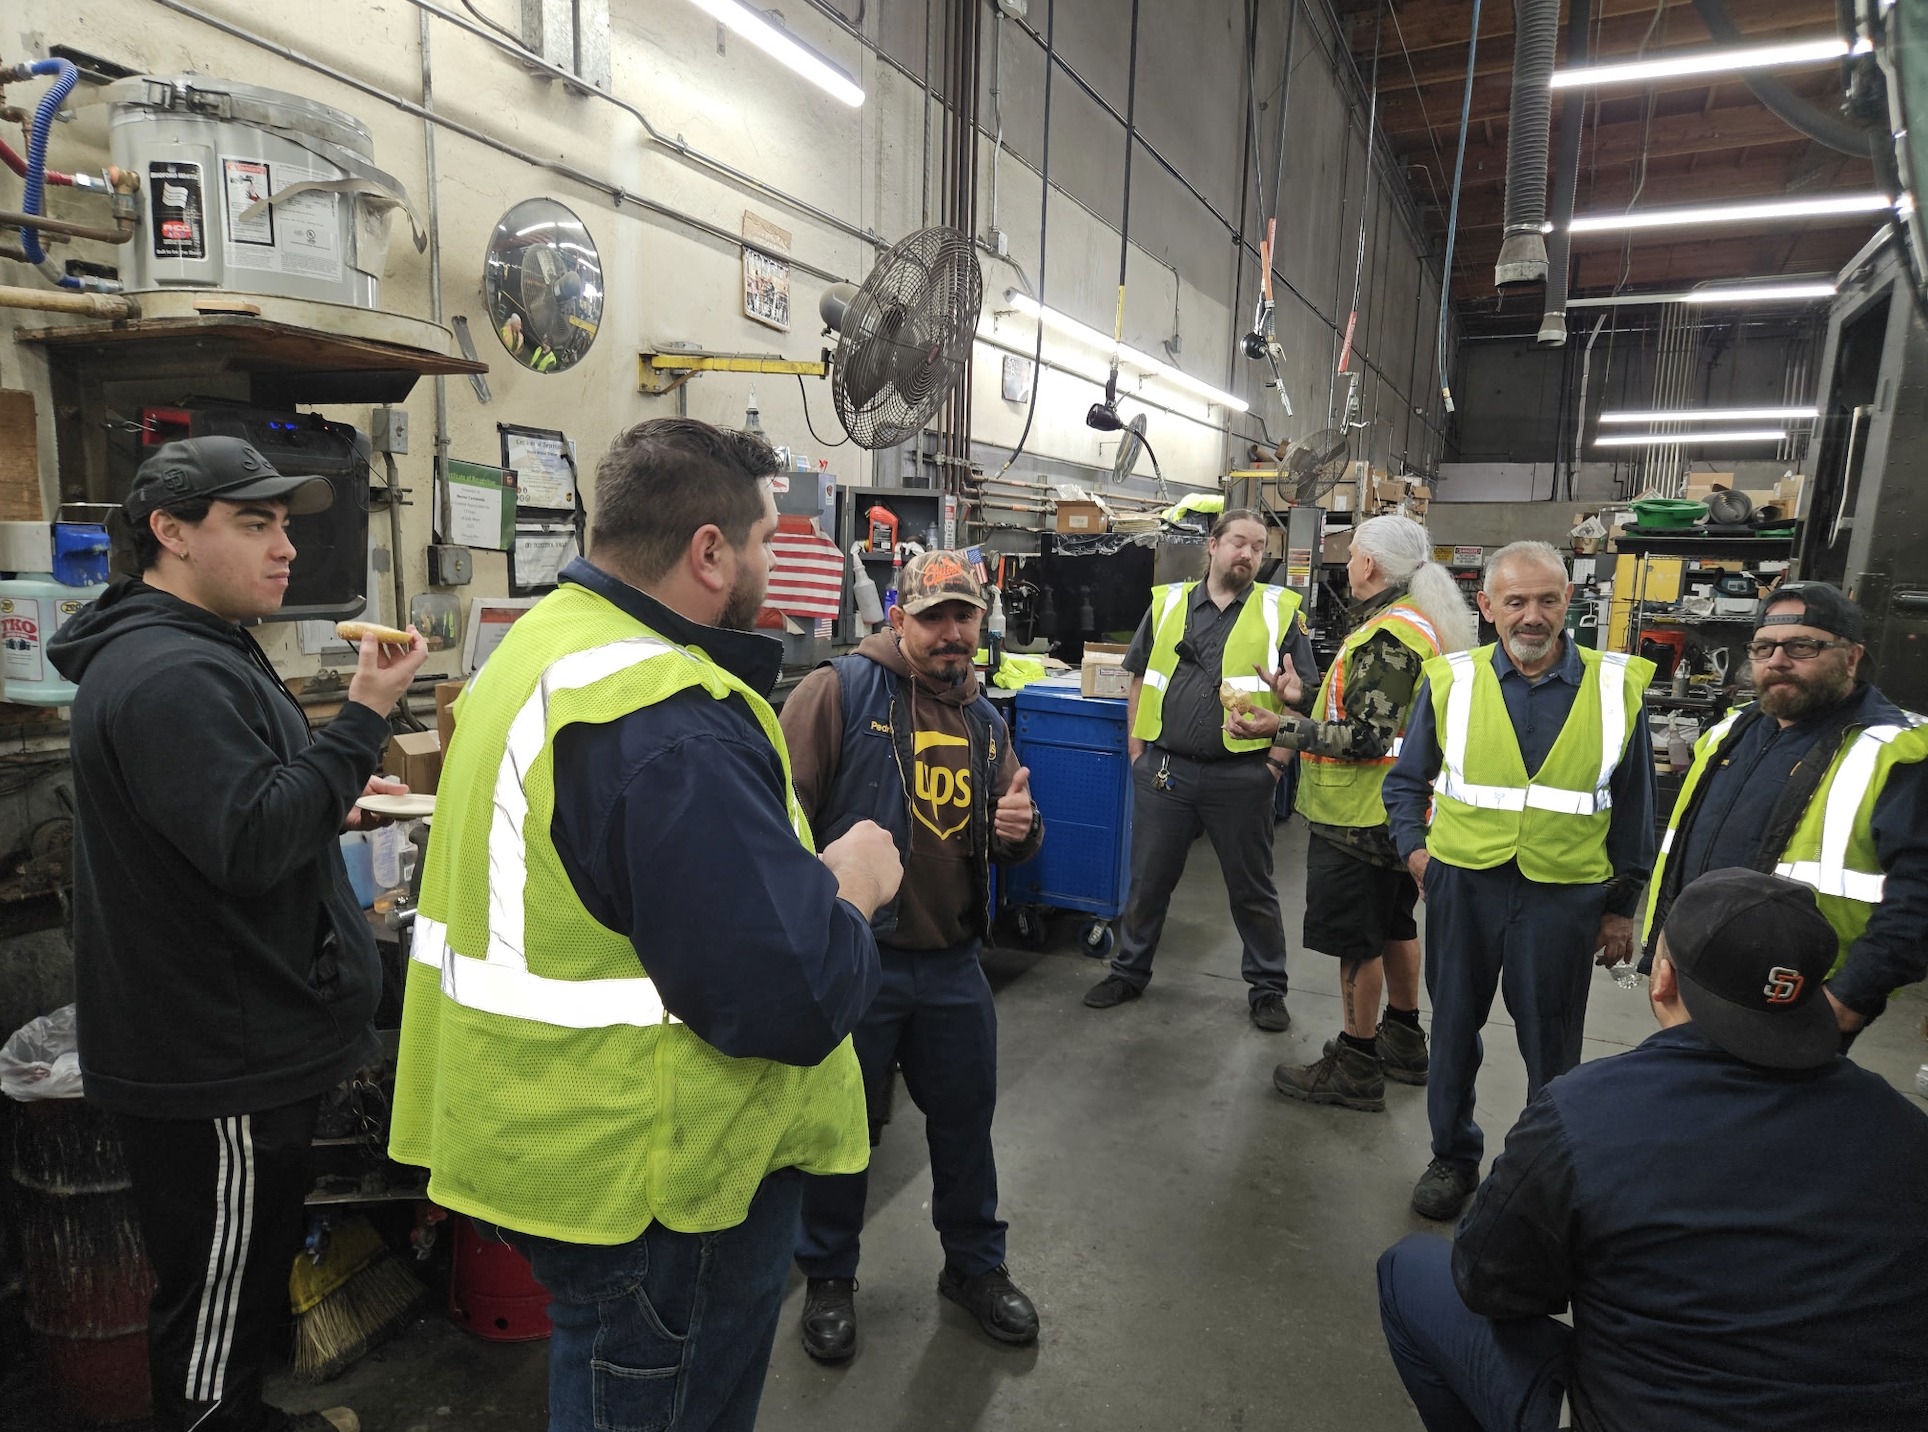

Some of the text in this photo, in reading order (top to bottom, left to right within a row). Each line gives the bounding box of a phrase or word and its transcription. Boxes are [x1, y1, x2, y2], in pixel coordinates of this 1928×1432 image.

[1, 618, 37, 634] TKO
[870, 720, 893, 734] Pedr
[914, 760, 972, 821] ups
